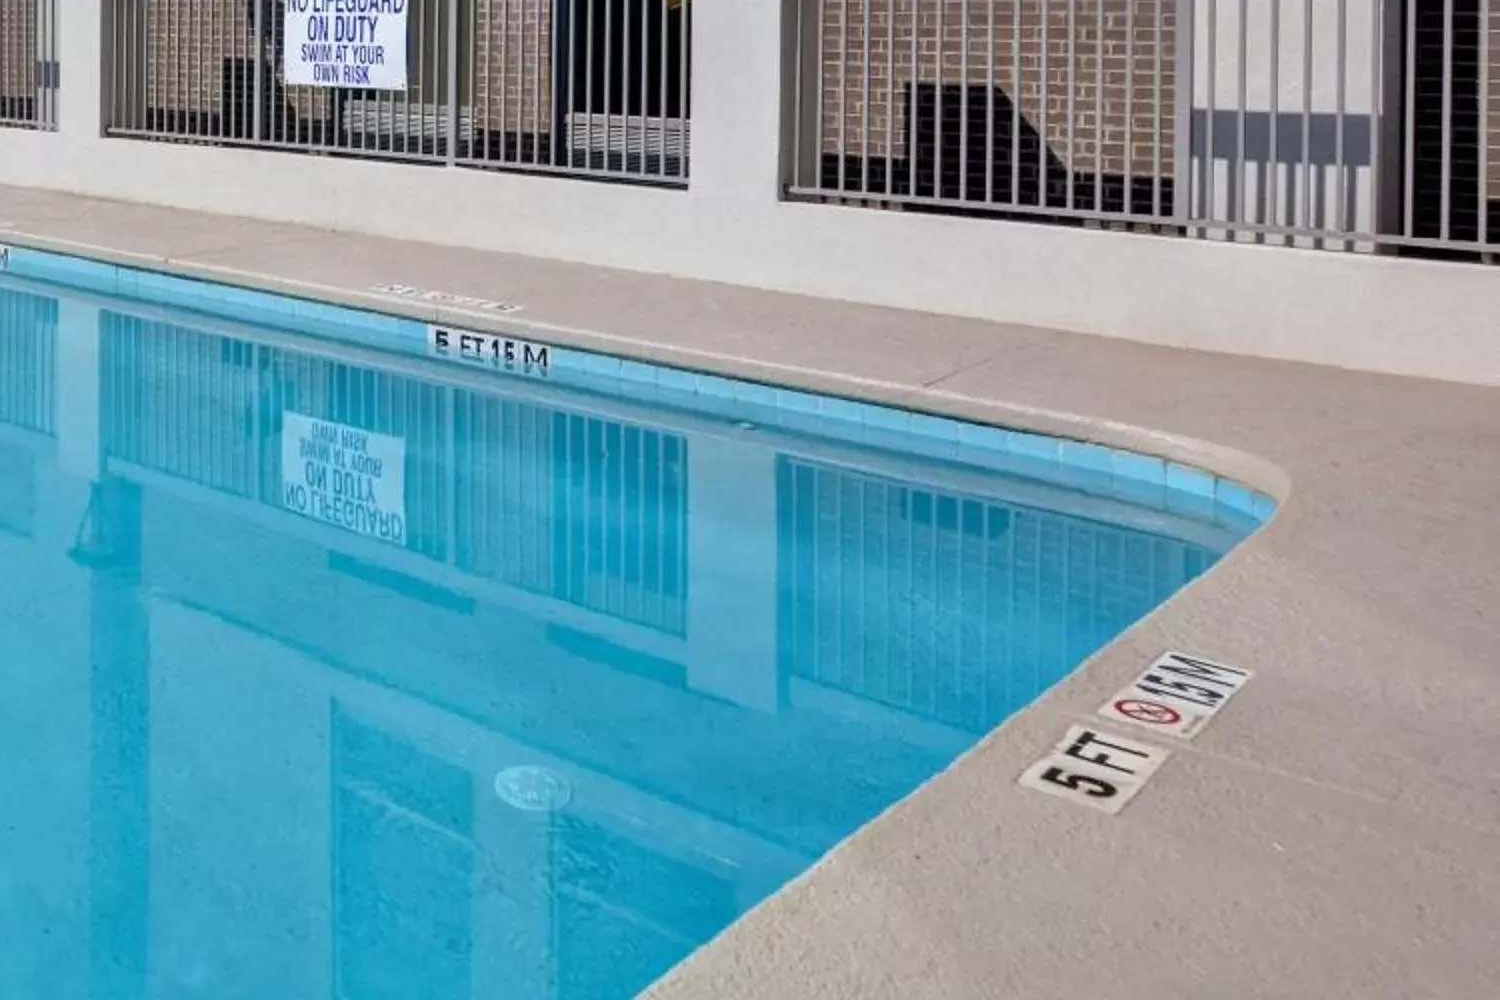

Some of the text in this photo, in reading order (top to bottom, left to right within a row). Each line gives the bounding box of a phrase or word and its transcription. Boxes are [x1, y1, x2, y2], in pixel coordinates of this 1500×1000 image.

[308, 16, 378, 42] ON DUTY
[301, 44, 384, 65] SWIM AT YOUR
[314, 64, 370, 85] OWN RISK
[435, 329, 449, 347] 5
[460, 334, 485, 354] FT
[524, 344, 548, 367] M
[1040, 731, 1149, 798] 5 FT
